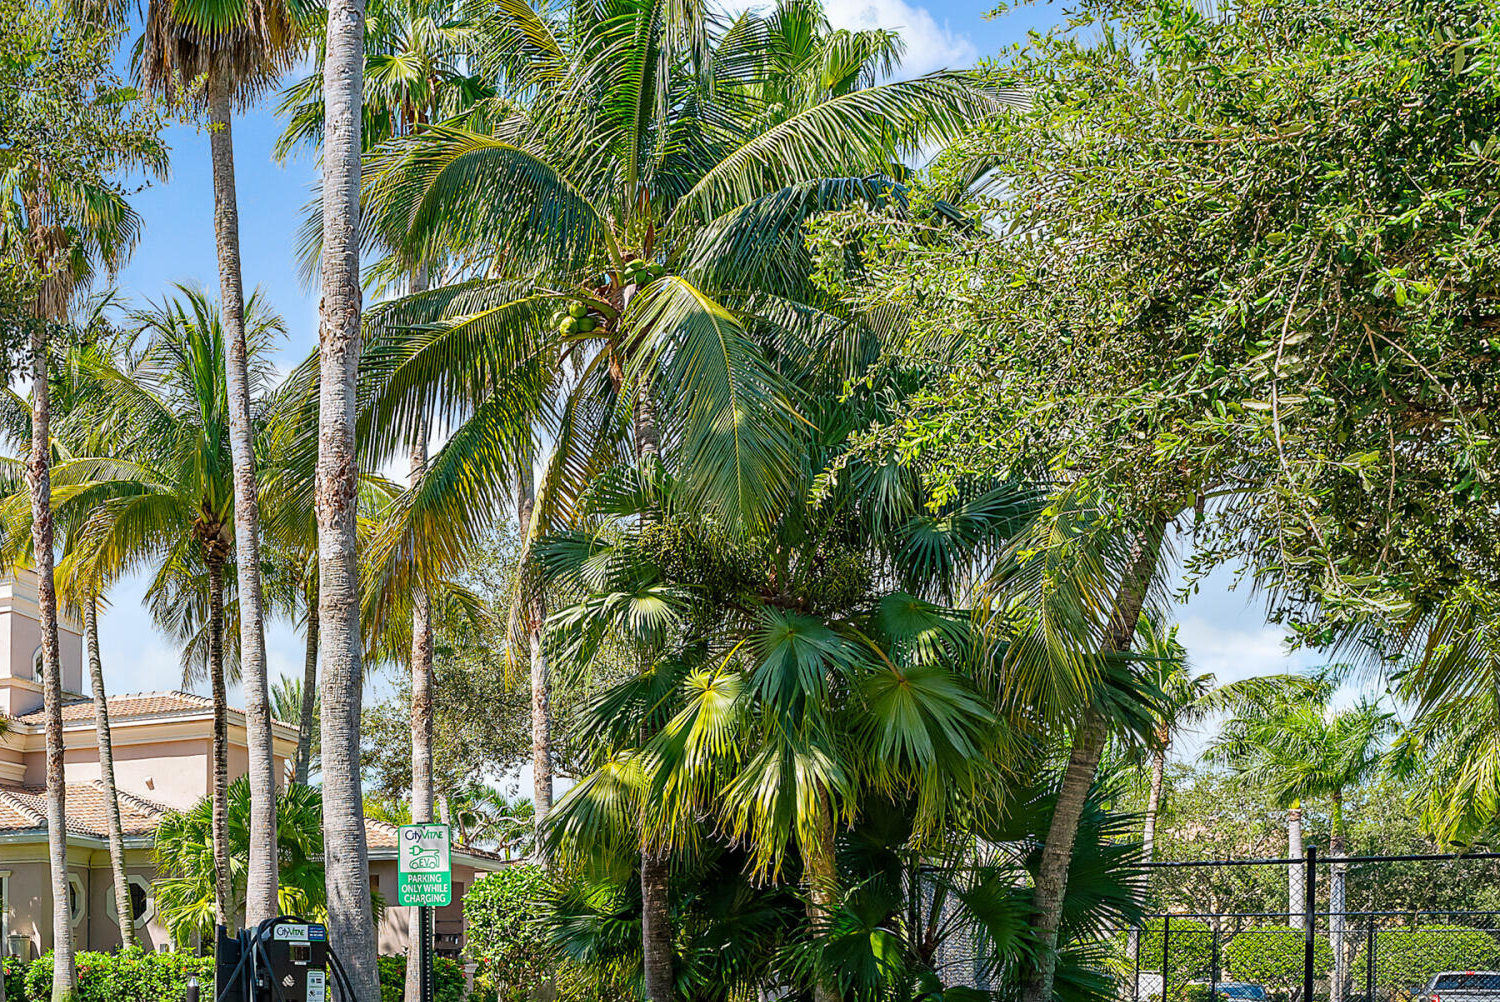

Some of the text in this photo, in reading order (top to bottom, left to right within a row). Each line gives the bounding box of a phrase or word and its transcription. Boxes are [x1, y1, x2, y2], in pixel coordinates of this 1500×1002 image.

[420, 858, 430, 867] EV
[407, 874, 442, 882] PARKING
[401, 884, 448, 893] ONLY WHILE
[404, 894, 446, 903] CHARGING
